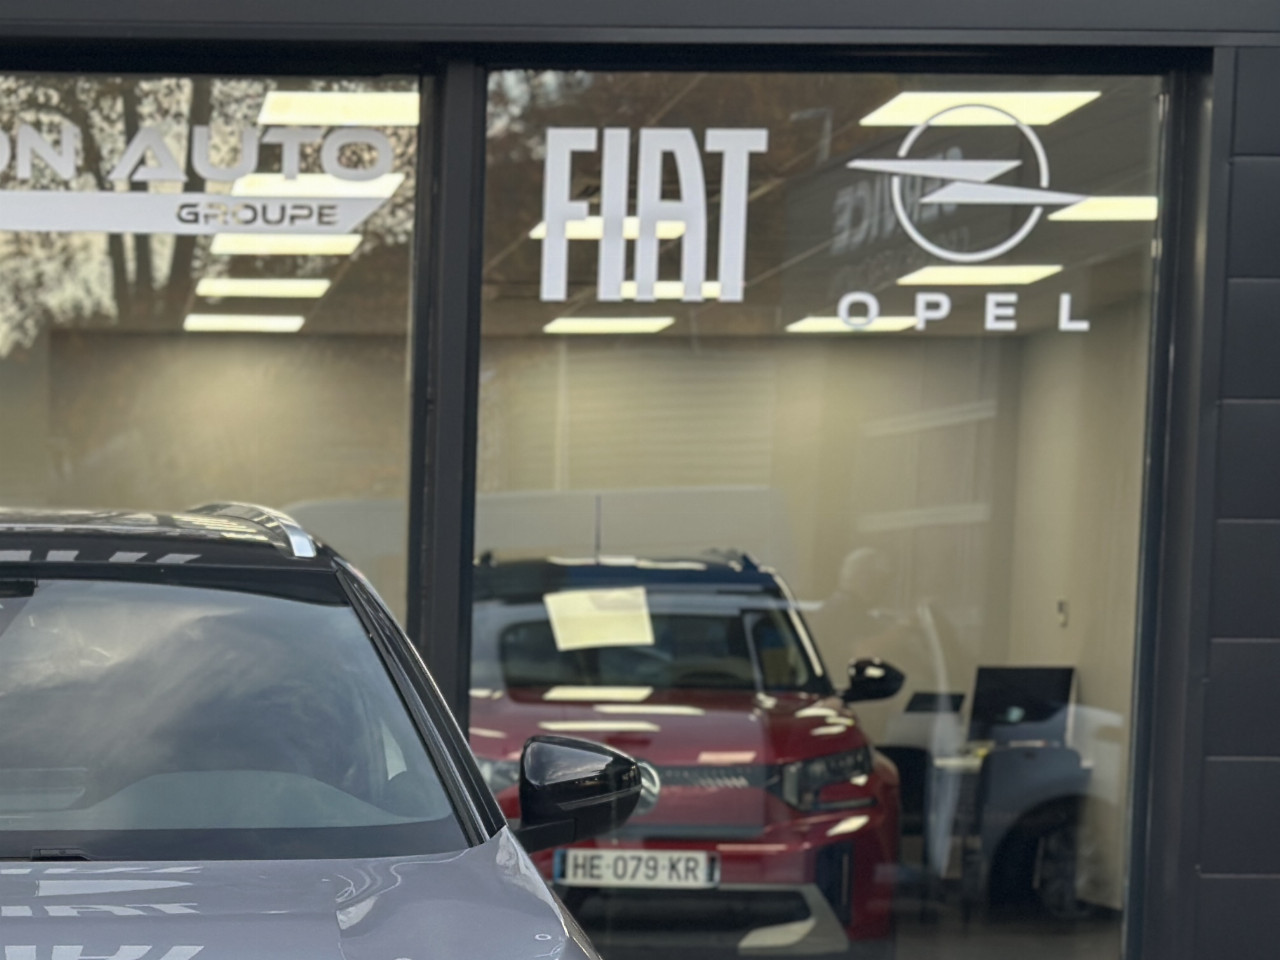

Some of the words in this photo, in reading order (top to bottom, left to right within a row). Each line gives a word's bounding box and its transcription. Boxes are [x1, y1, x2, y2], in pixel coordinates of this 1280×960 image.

[107, 122, 396, 183] AUTO
[175, 202, 340, 227] GROUPE
[540, 126, 769, 302] FIAT
[837, 291, 1091, 332] OPEL
